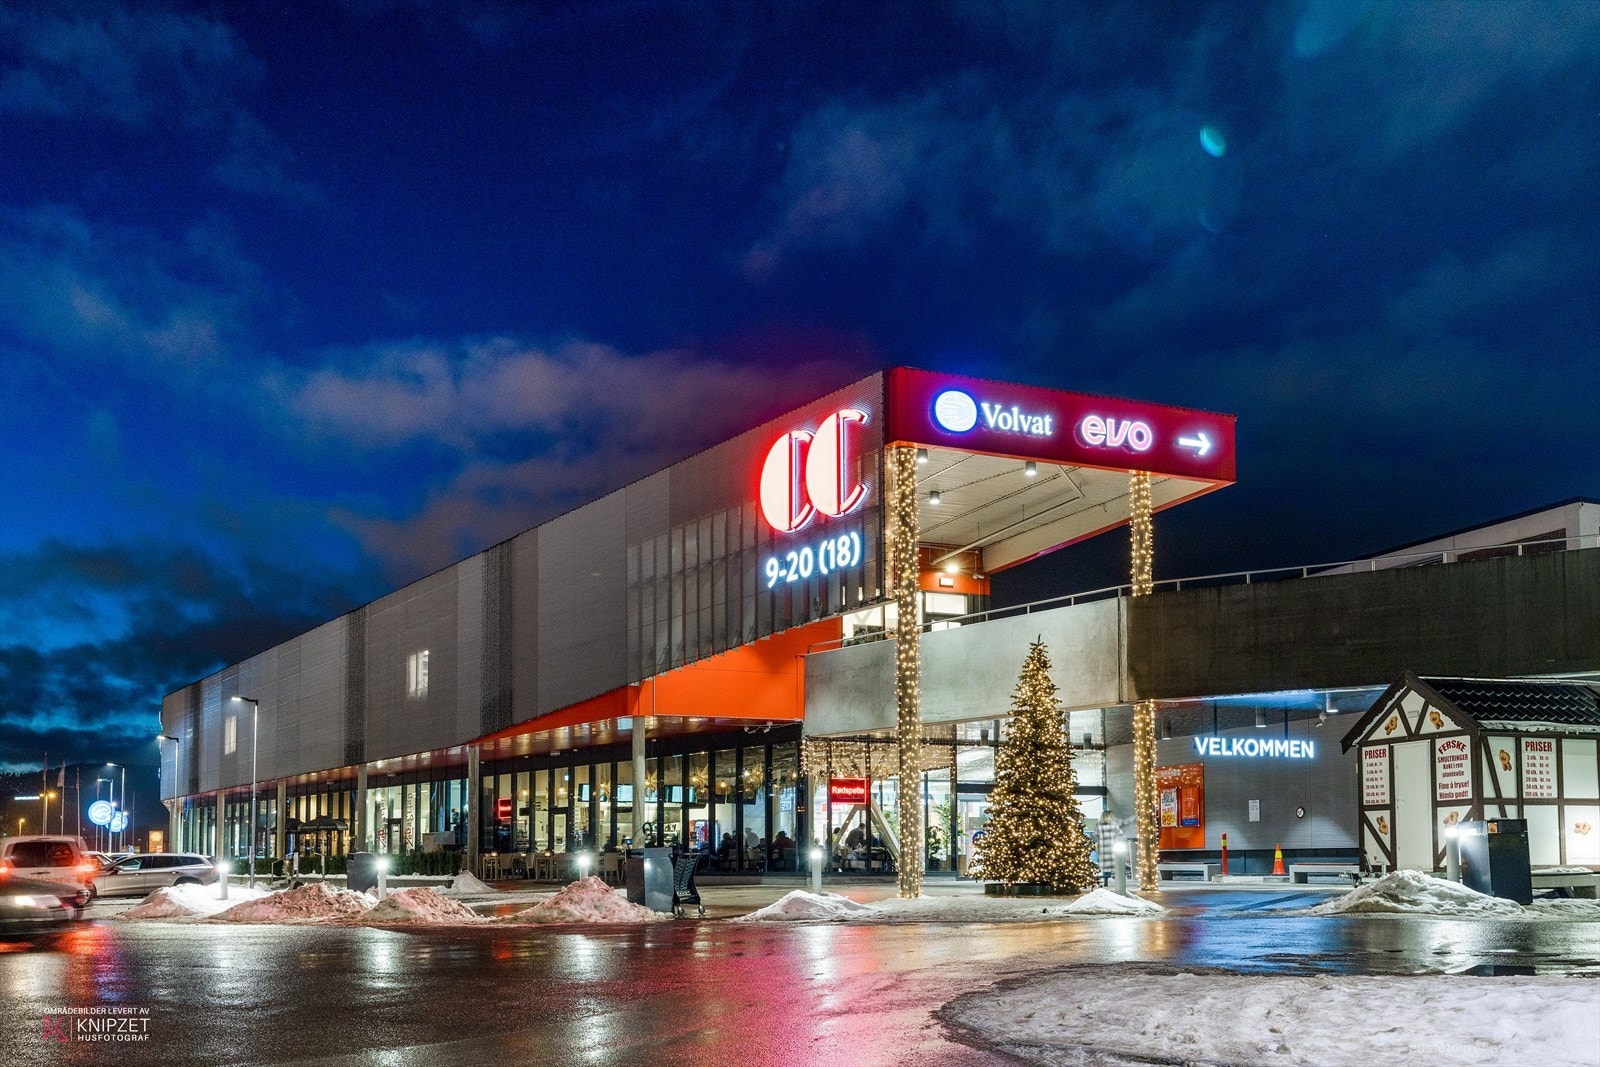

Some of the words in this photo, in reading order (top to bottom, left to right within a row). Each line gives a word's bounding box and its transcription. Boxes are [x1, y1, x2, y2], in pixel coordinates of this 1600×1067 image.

[981, 402, 1052, 435] Volvat
[1081, 415, 1152, 450] evo
[760, 409, 868, 533] CC
[766, 546, 813, 588] 9-20
[819, 532, 860, 574] (18)
[1195, 737, 1314, 758] VELKOMMEN
[1364, 748, 1386, 759] PRISER
[1438, 740, 1467, 754] FERSKE
[1525, 741, 1552, 752] PRISER
